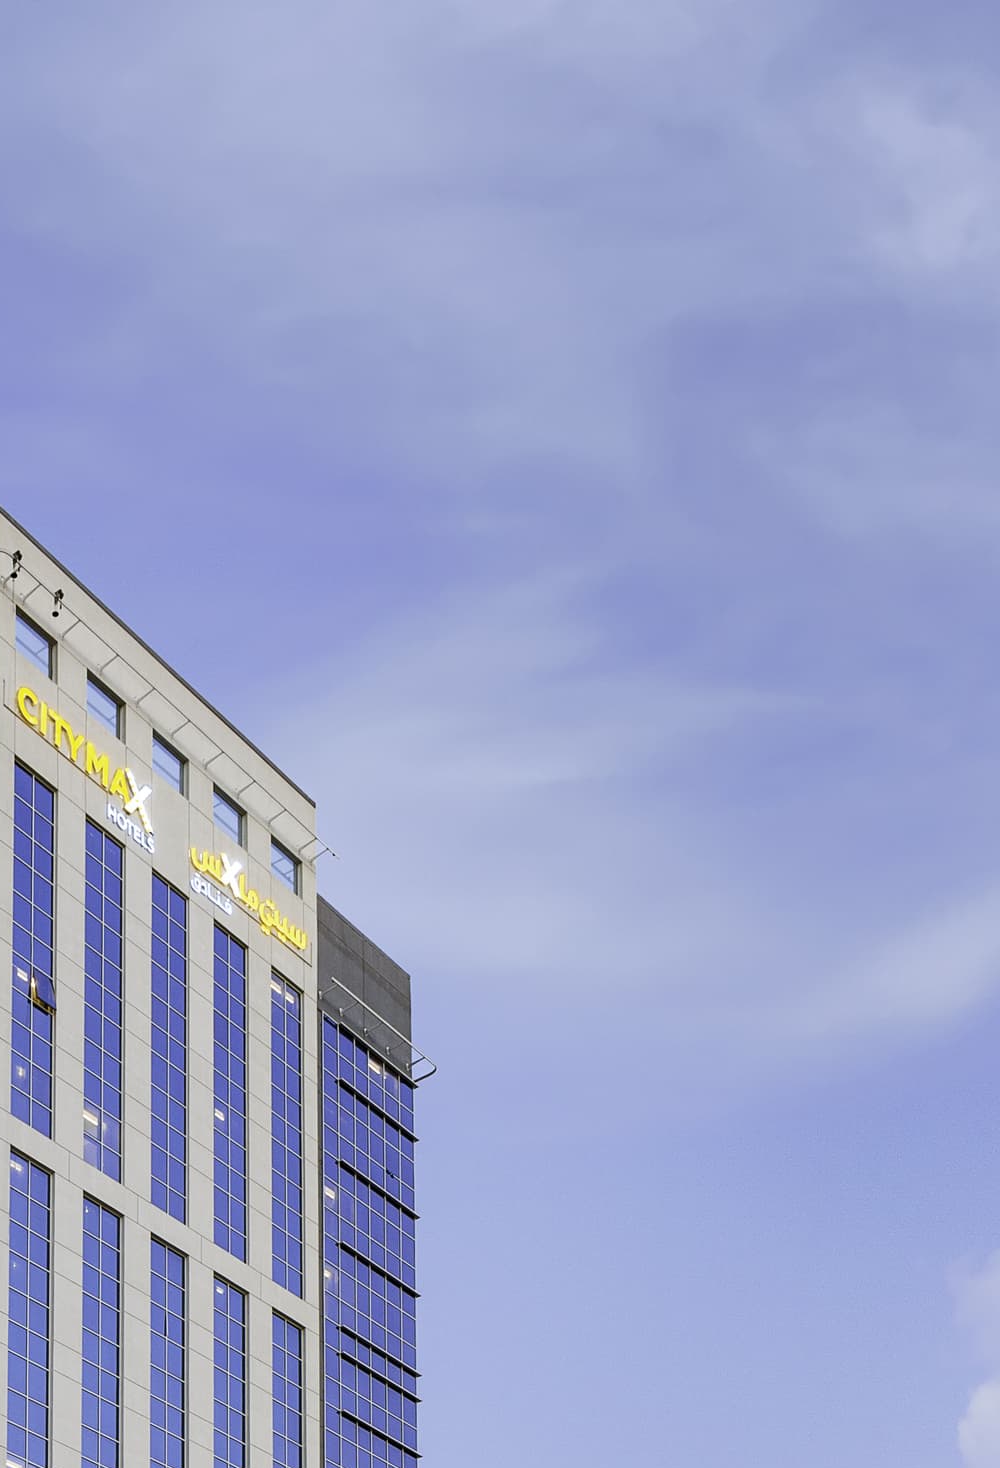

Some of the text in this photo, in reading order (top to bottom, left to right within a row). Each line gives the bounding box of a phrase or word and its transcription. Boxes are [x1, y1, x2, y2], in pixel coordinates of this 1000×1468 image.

[16, 687, 153, 834] CITYMAX
[107, 803, 154, 853] HOTELS
[190, 872, 232, 915] فنادق
